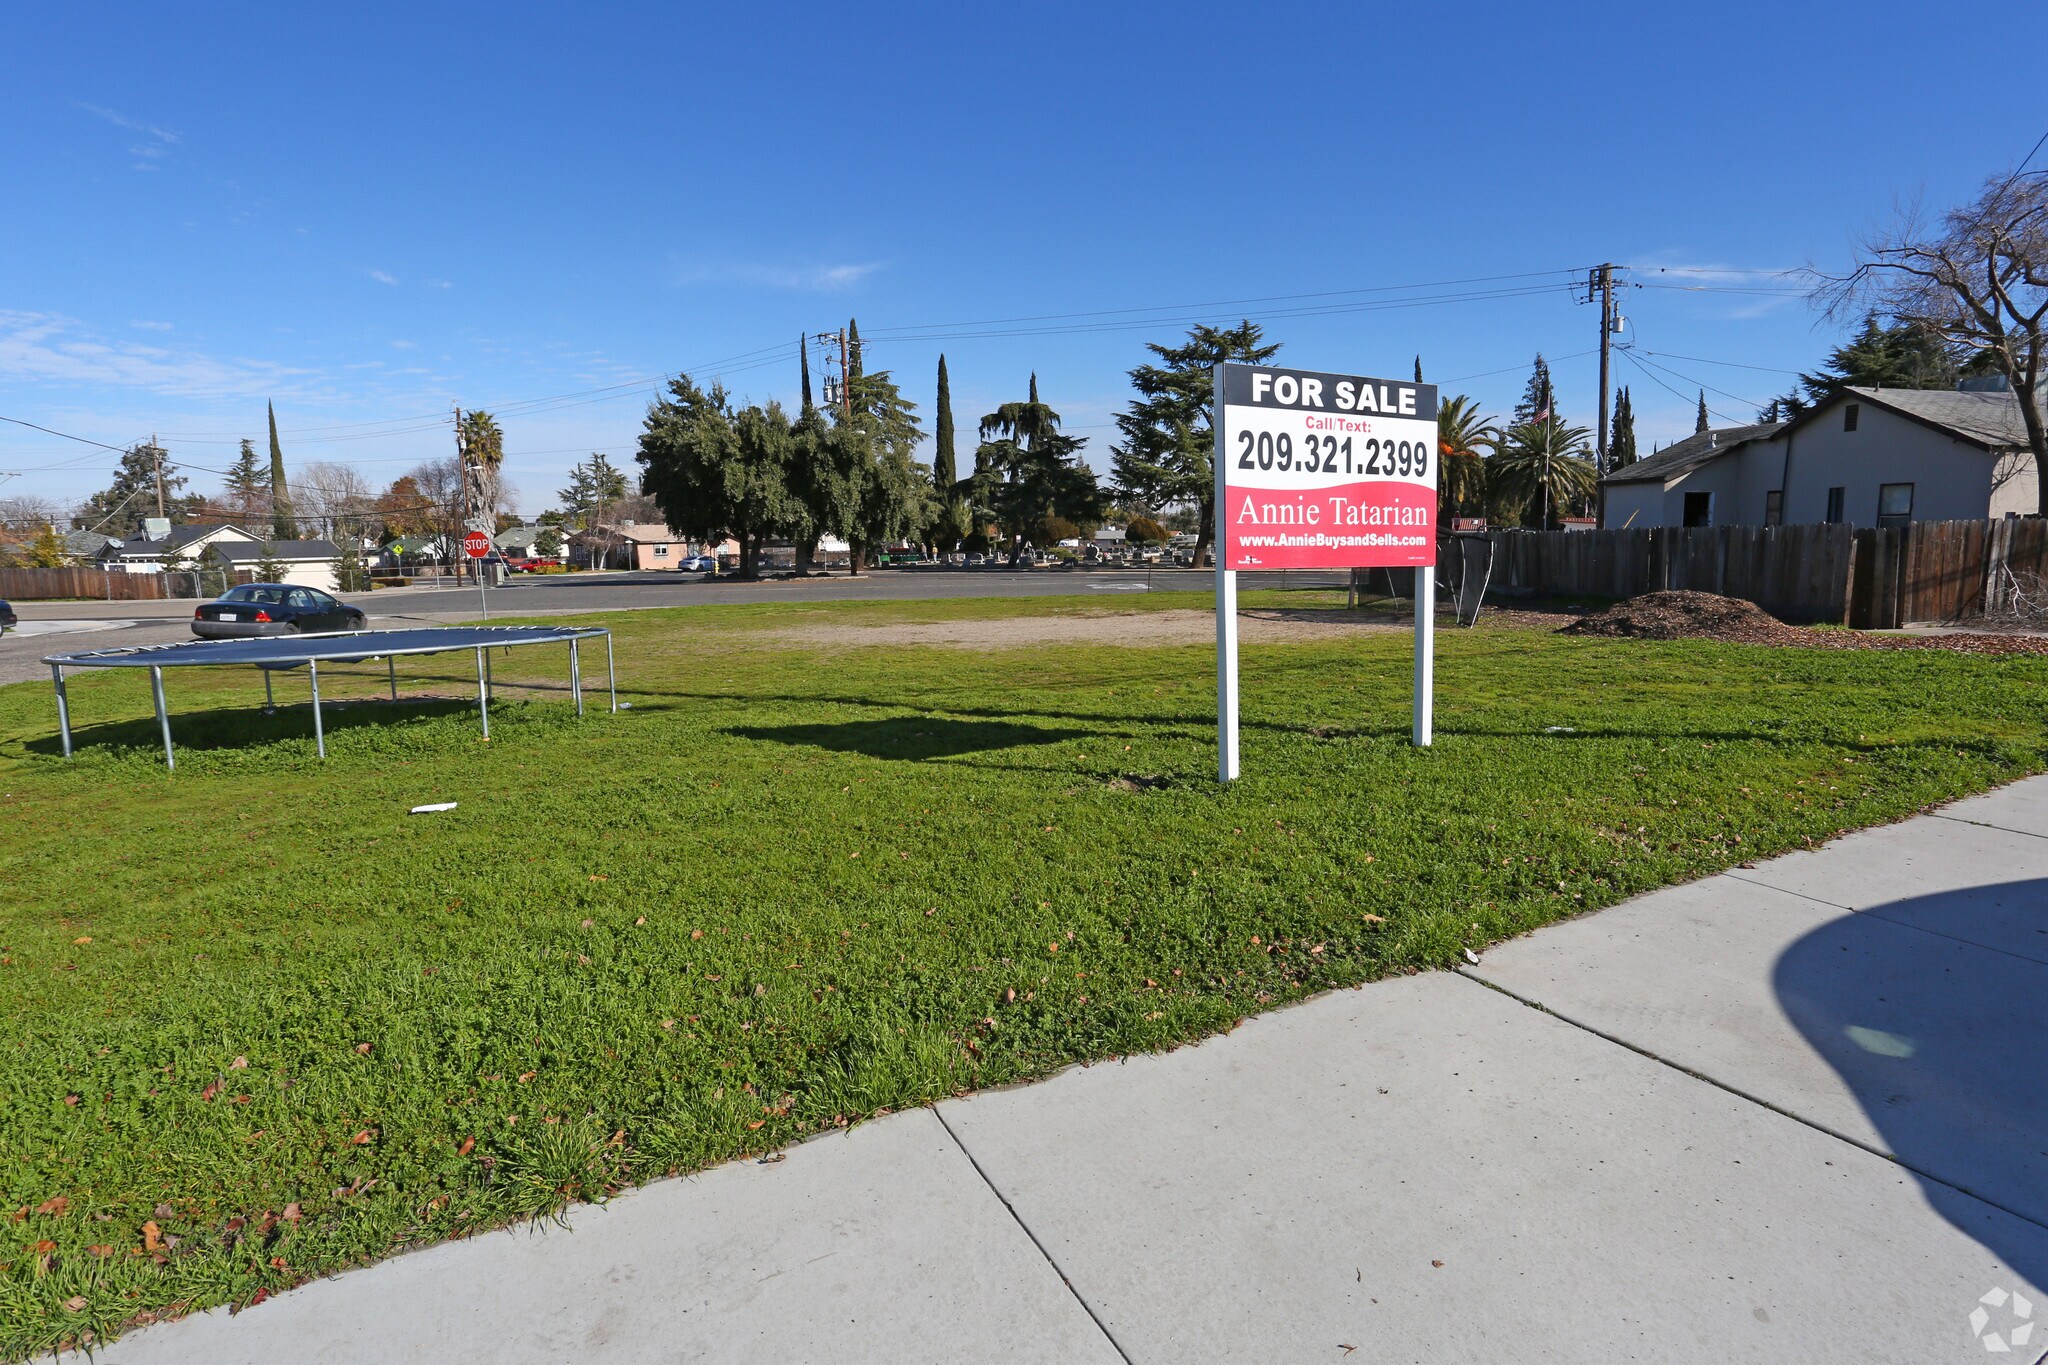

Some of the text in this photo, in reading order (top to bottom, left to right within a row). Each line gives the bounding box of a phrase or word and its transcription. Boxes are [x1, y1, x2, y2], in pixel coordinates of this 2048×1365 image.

[1252, 372, 1417, 416] FOR SALE
[1305, 415, 1372, 433] Call/Text:
[1237, 430, 1427, 477] 209.321.2399
[1236, 494, 1428, 526] Annie Tatarian
[466, 539, 488, 550] STOP
[1239, 533, 1426, 549] www.AnnieBuysandSells.com
